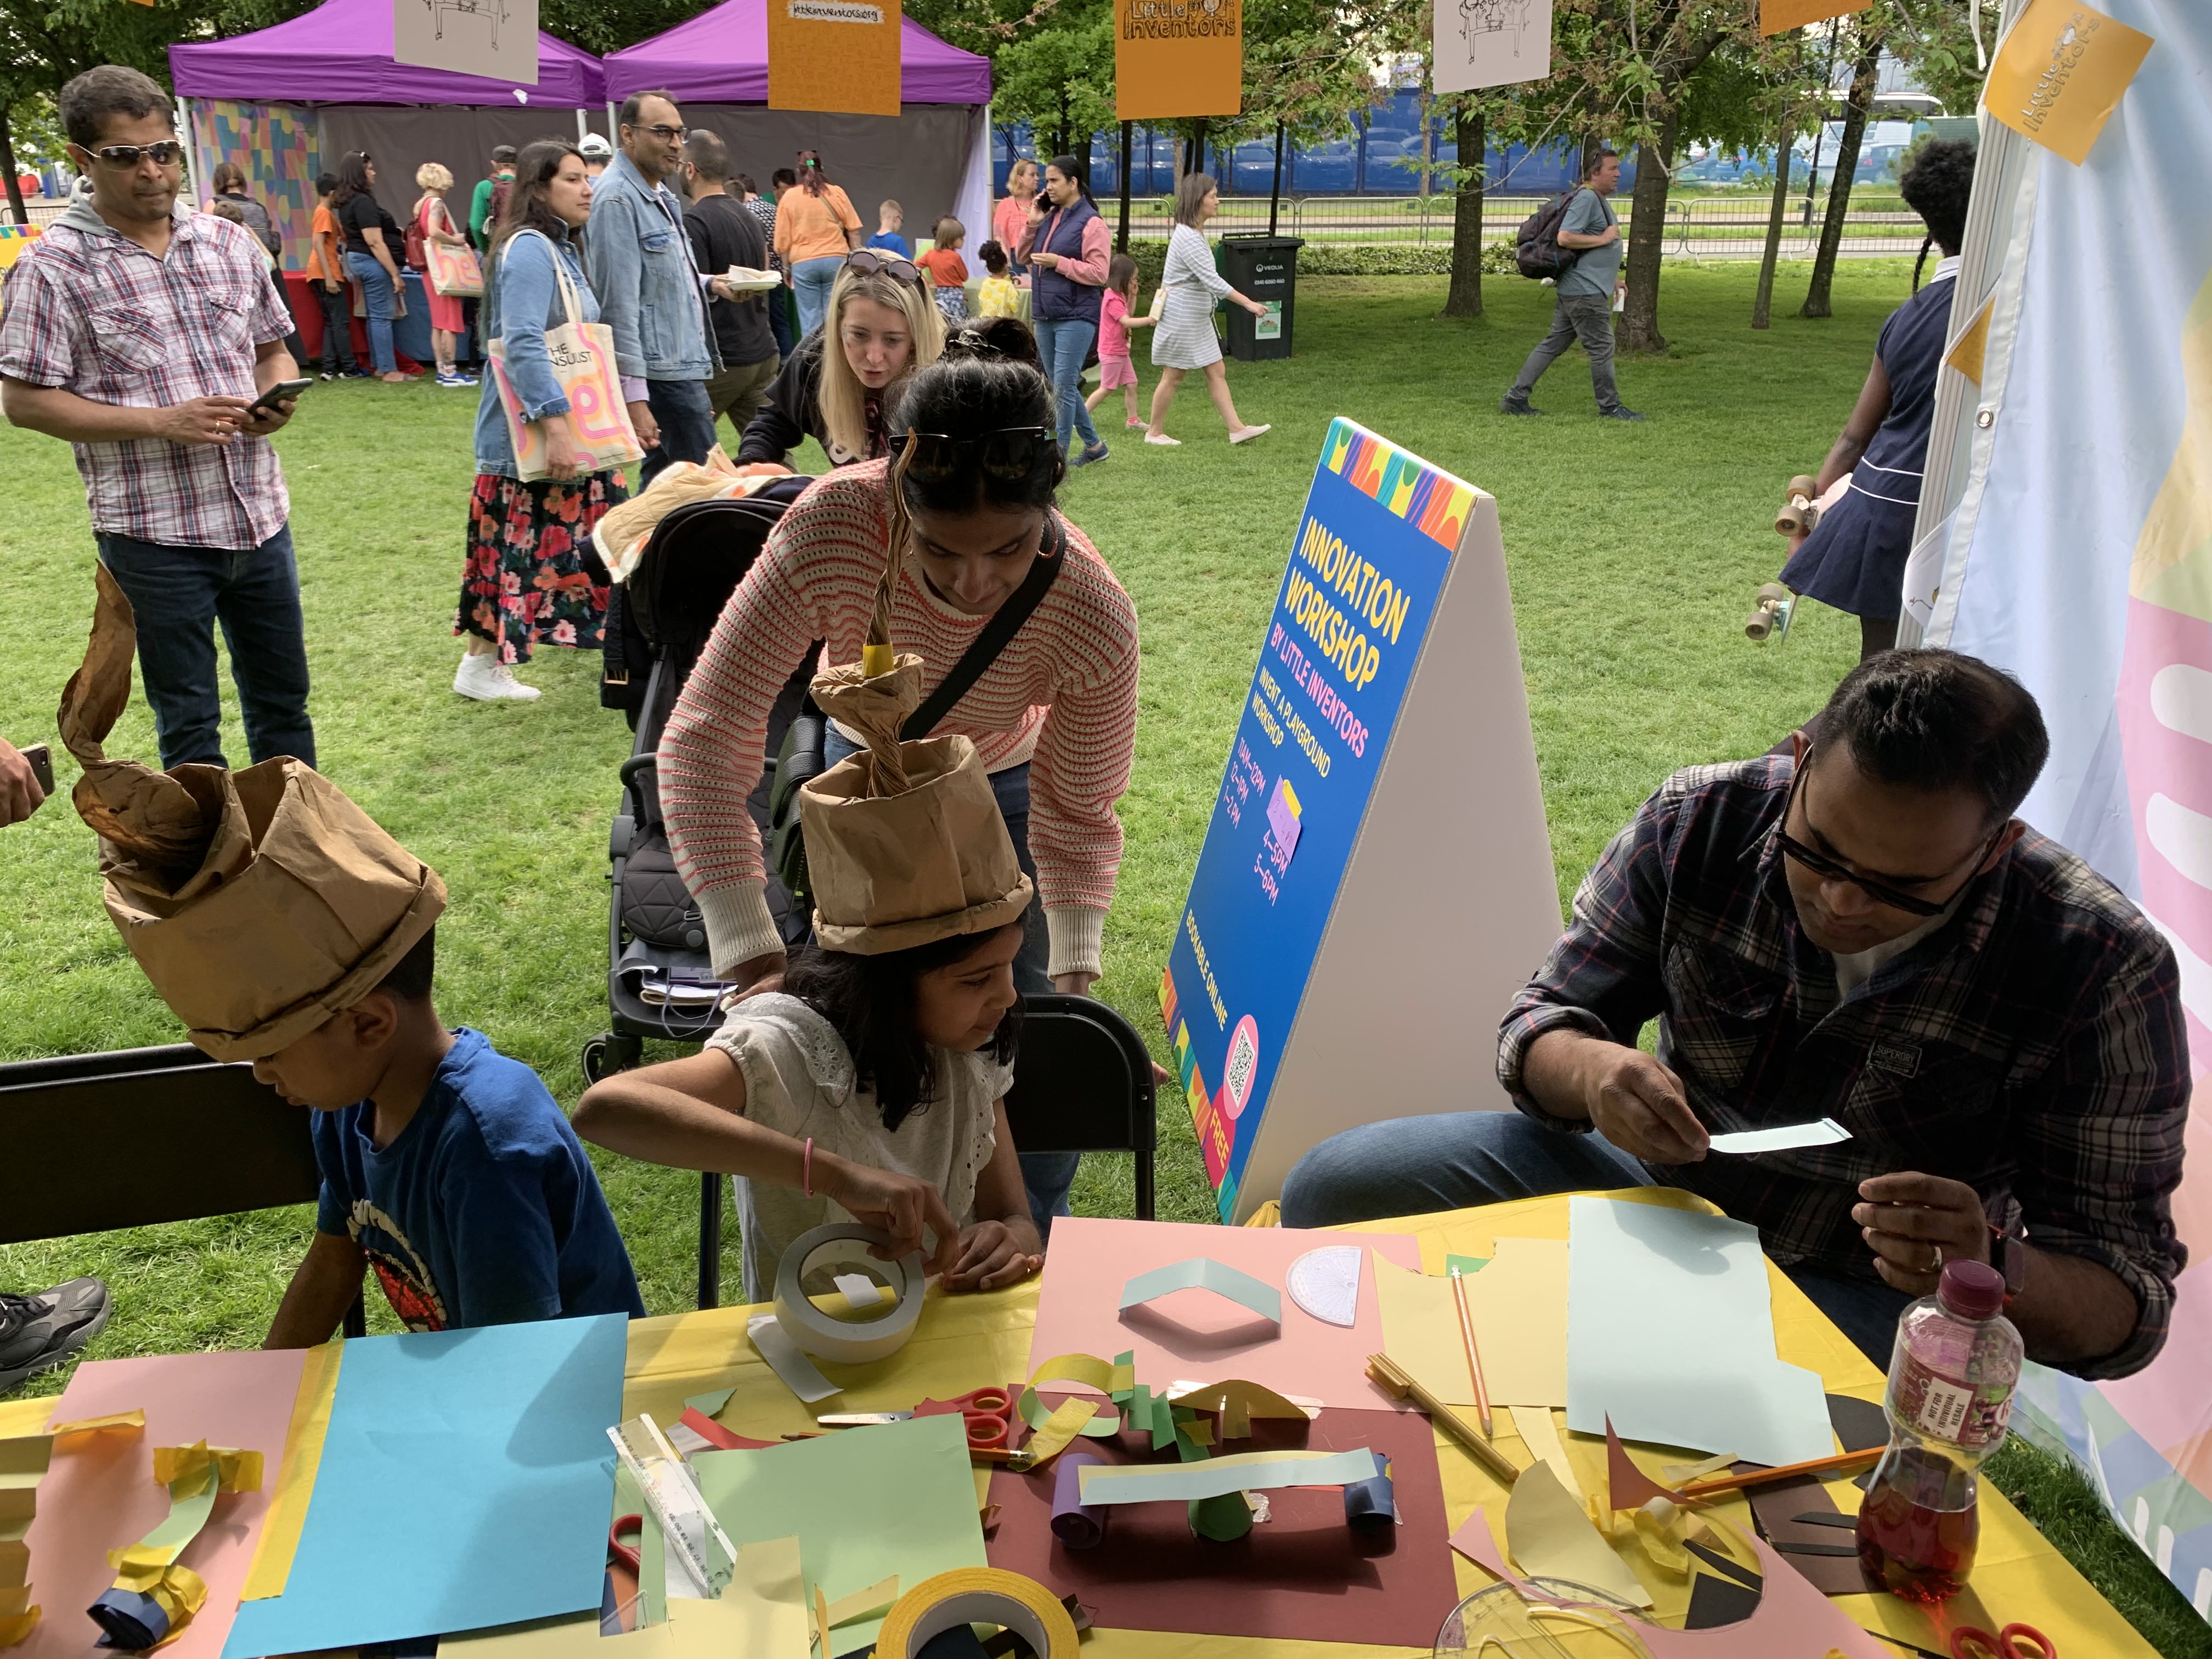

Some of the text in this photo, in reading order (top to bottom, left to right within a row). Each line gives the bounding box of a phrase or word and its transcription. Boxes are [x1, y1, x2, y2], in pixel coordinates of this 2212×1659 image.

[1123, 12, 1236, 40] Inventors
[2022, 64, 2059, 117] Little
[2023, 18, 2101, 132] Inventors
[1299, 516, 1410, 645] INNOVATION
[1285, 566, 1380, 691] WORKSHOP
[1252, 690, 1284, 748] WORKSHOP
[1271, 622, 1368, 758] BY LITTLE INVENTORS
[1259, 665, 1330, 778] INVENT A PLAYGROUND
[1186, 909, 1228, 1032] BOOKABLE ONLINE
[1210, 1108, 1229, 1169] FREE
[1927, 1392, 1943, 1419] NOT FOR
[1937, 1394, 1956, 1429] INDIVIDUAL
[1951, 1403, 1965, 1426] RESALE
